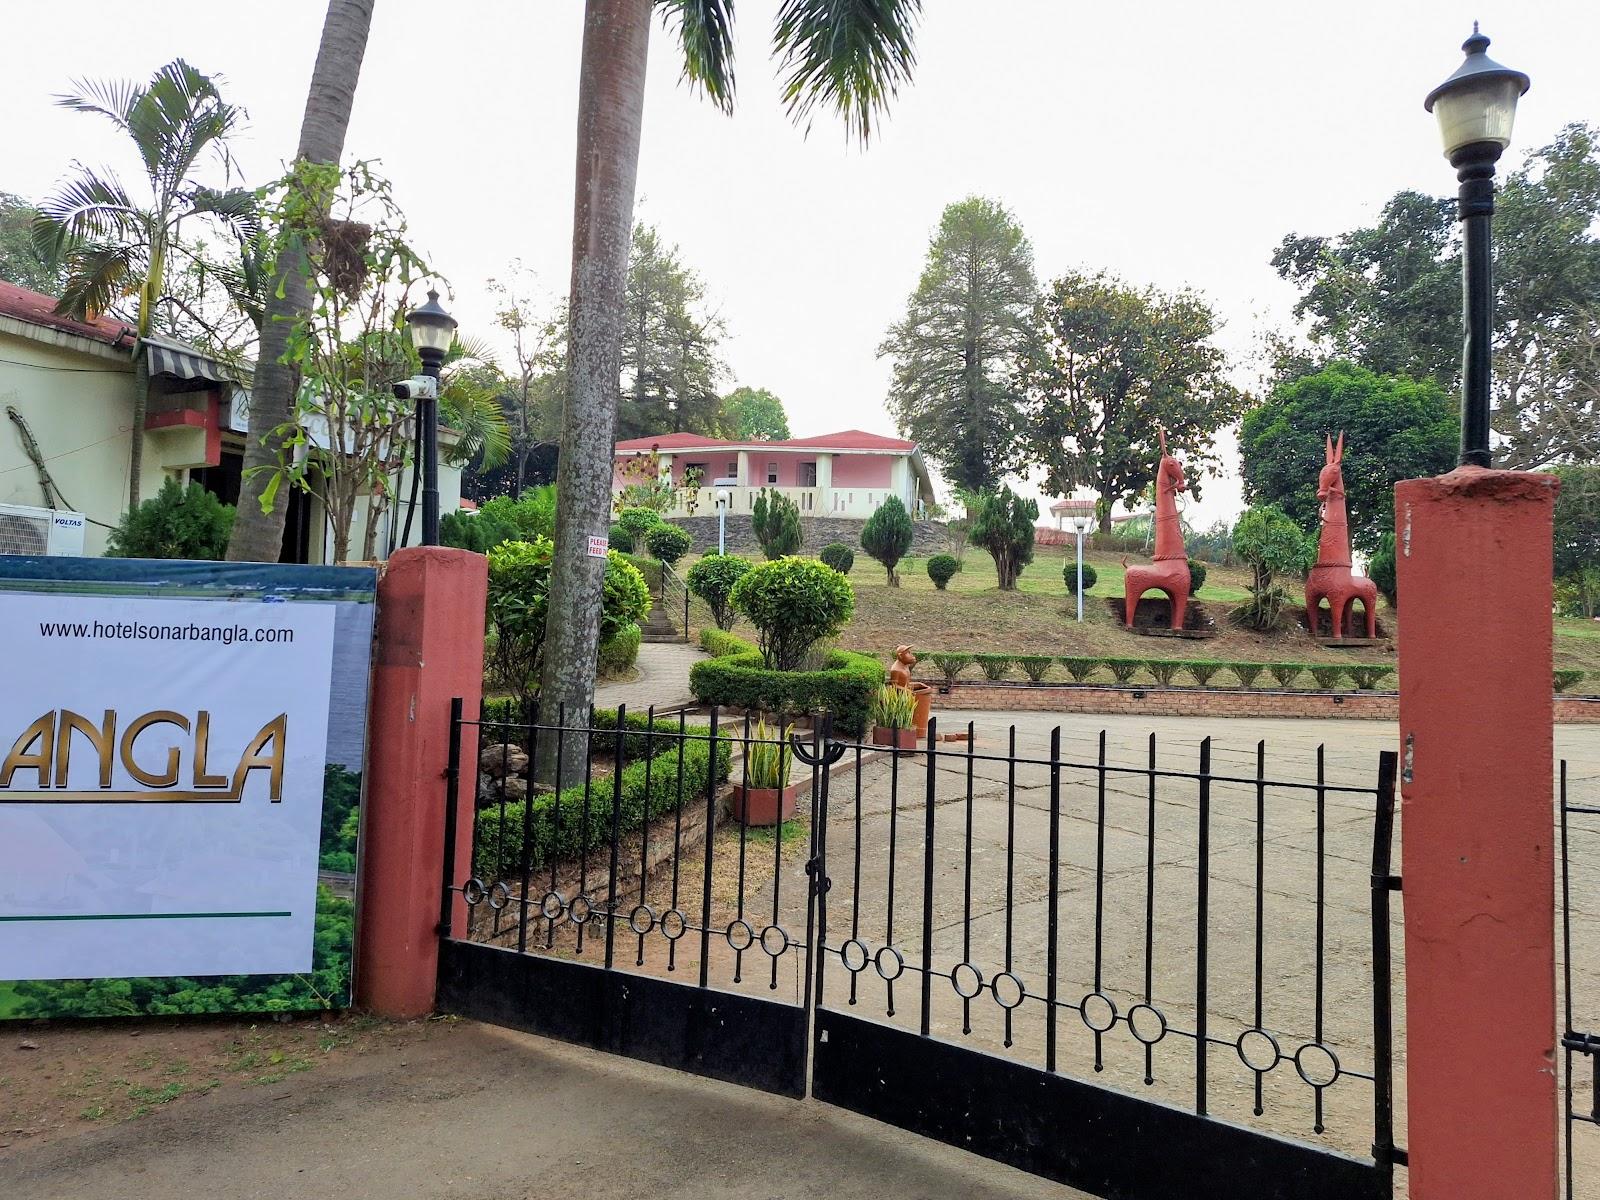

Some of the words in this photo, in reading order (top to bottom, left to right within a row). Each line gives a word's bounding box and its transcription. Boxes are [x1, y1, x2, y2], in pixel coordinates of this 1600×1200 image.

[55, 518, 82, 526] VOLTAS
[40, 620, 294, 645] www.hotelsonarbangla.com
[0, 709, 288, 803] ANGLA
